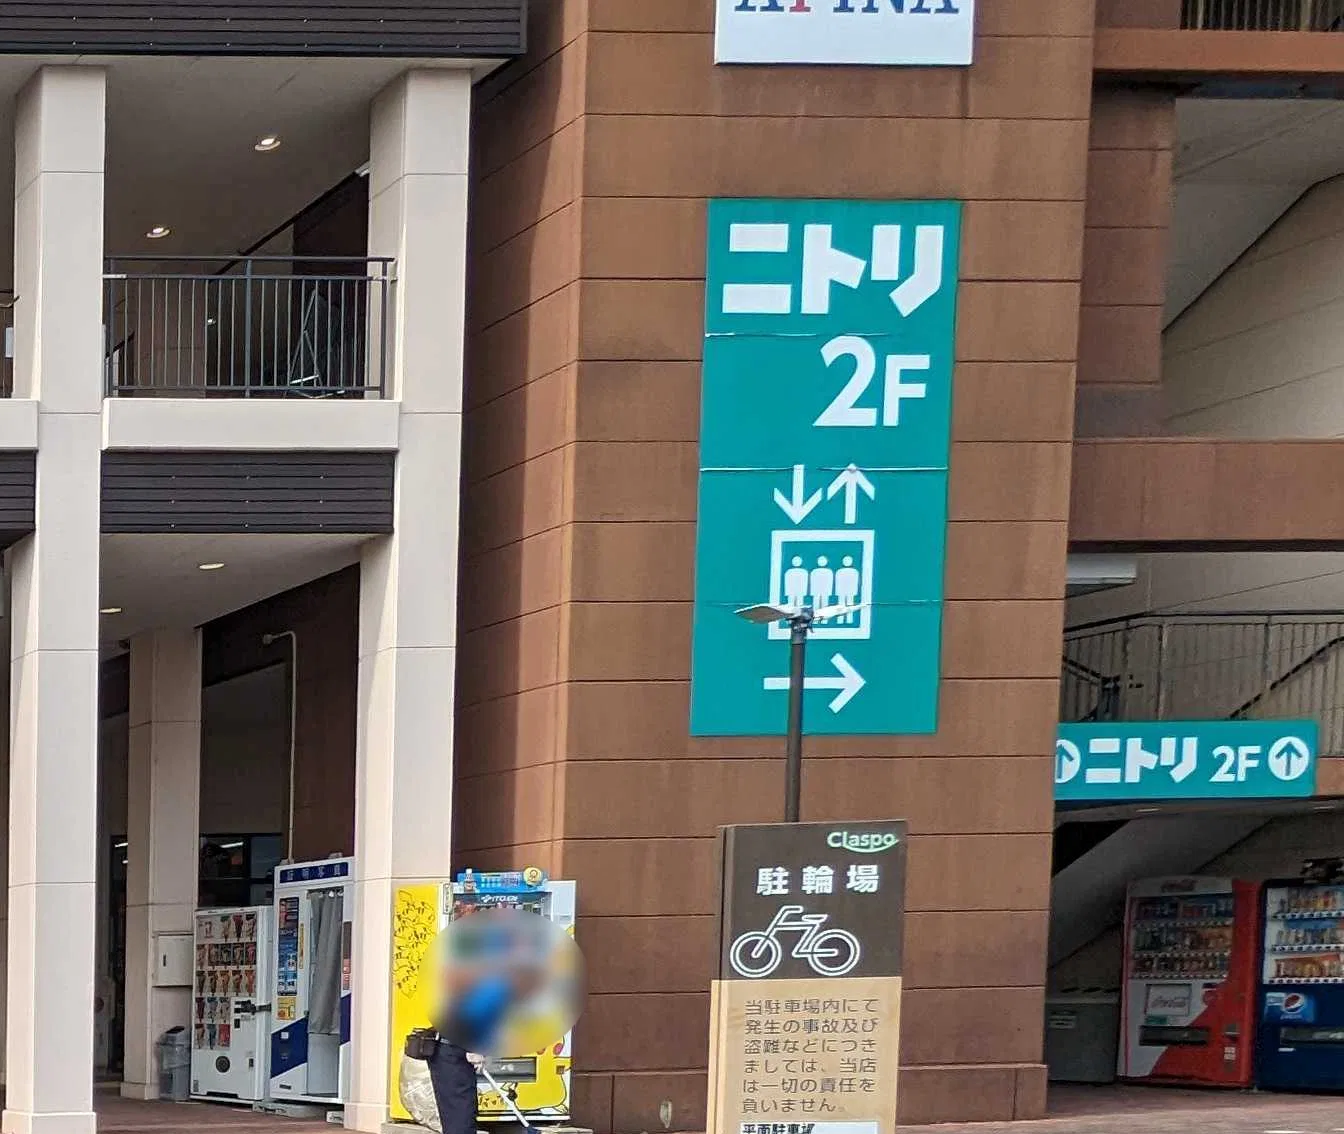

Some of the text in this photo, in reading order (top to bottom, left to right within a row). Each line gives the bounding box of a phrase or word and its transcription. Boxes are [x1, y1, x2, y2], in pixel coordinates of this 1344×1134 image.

[723, 223, 944, 317] ニトリ
[813, 335, 931, 427] 2F
[1086, 736, 1261, 784] ニトリ 2F
[827, 831, 899, 853] Claspo
[756, 865, 880, 896] 駐輪場
[745, 999, 879, 1016] 当駐車場内にて
[745, 1019, 878, 1035] 発生の事故及び
[744, 1038, 877, 1054] 盗難などにつき
[743, 1057, 877, 1074] ましては、当店
[743, 1077, 876, 1094] は一切の責任を
[741, 1097, 847, 1114] 負いません。
